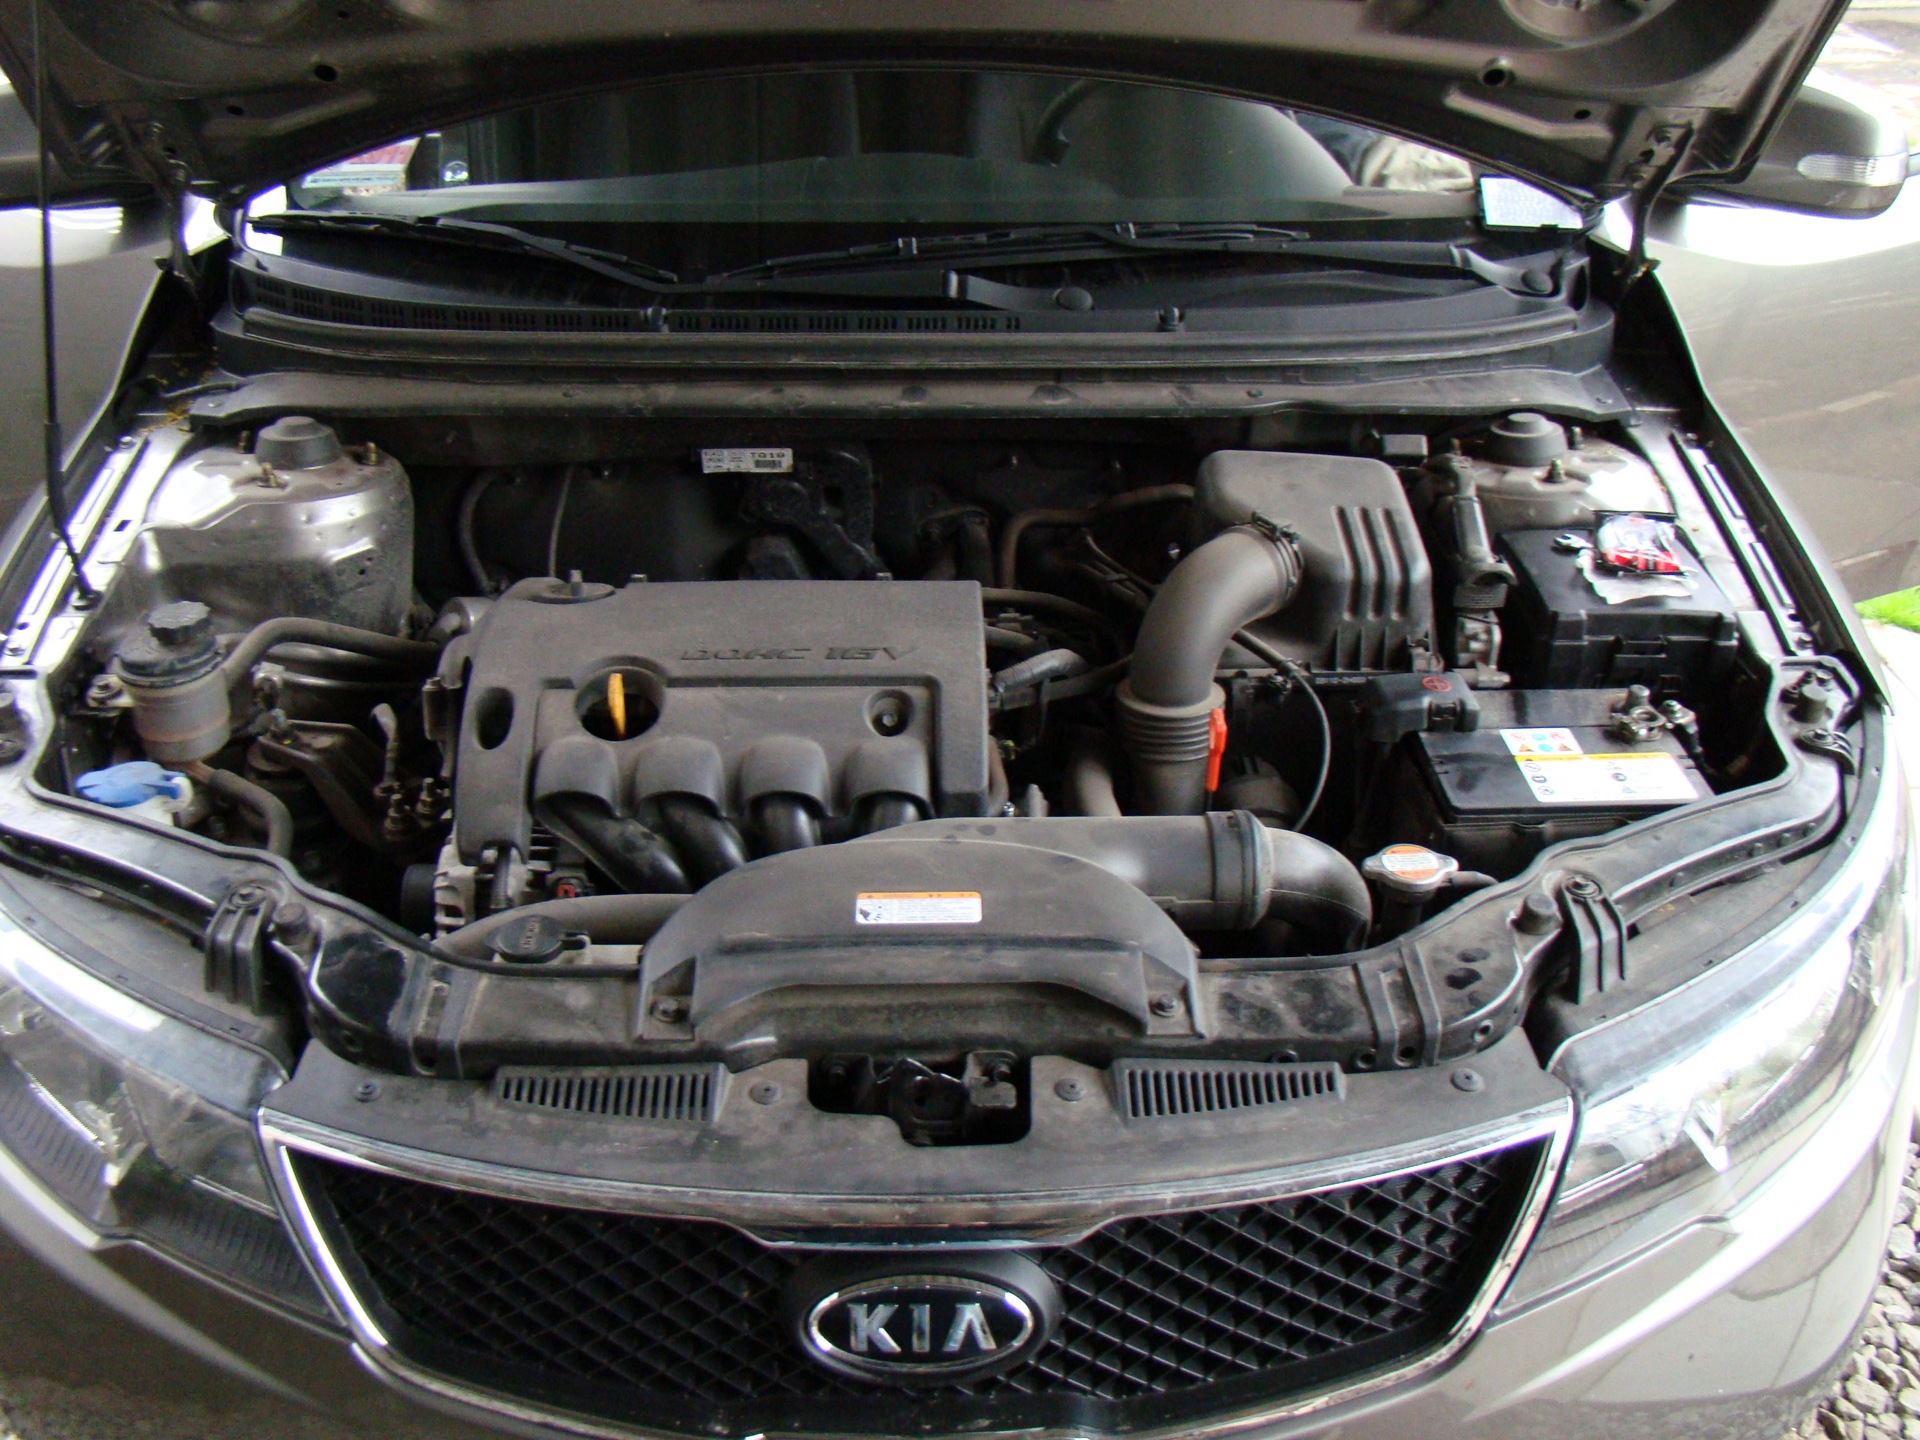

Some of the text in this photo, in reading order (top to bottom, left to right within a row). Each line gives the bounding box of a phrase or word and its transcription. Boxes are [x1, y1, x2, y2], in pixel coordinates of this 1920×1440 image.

[680, 647, 918, 661] DOHC 16V
[847, 1303, 998, 1352] KIA
